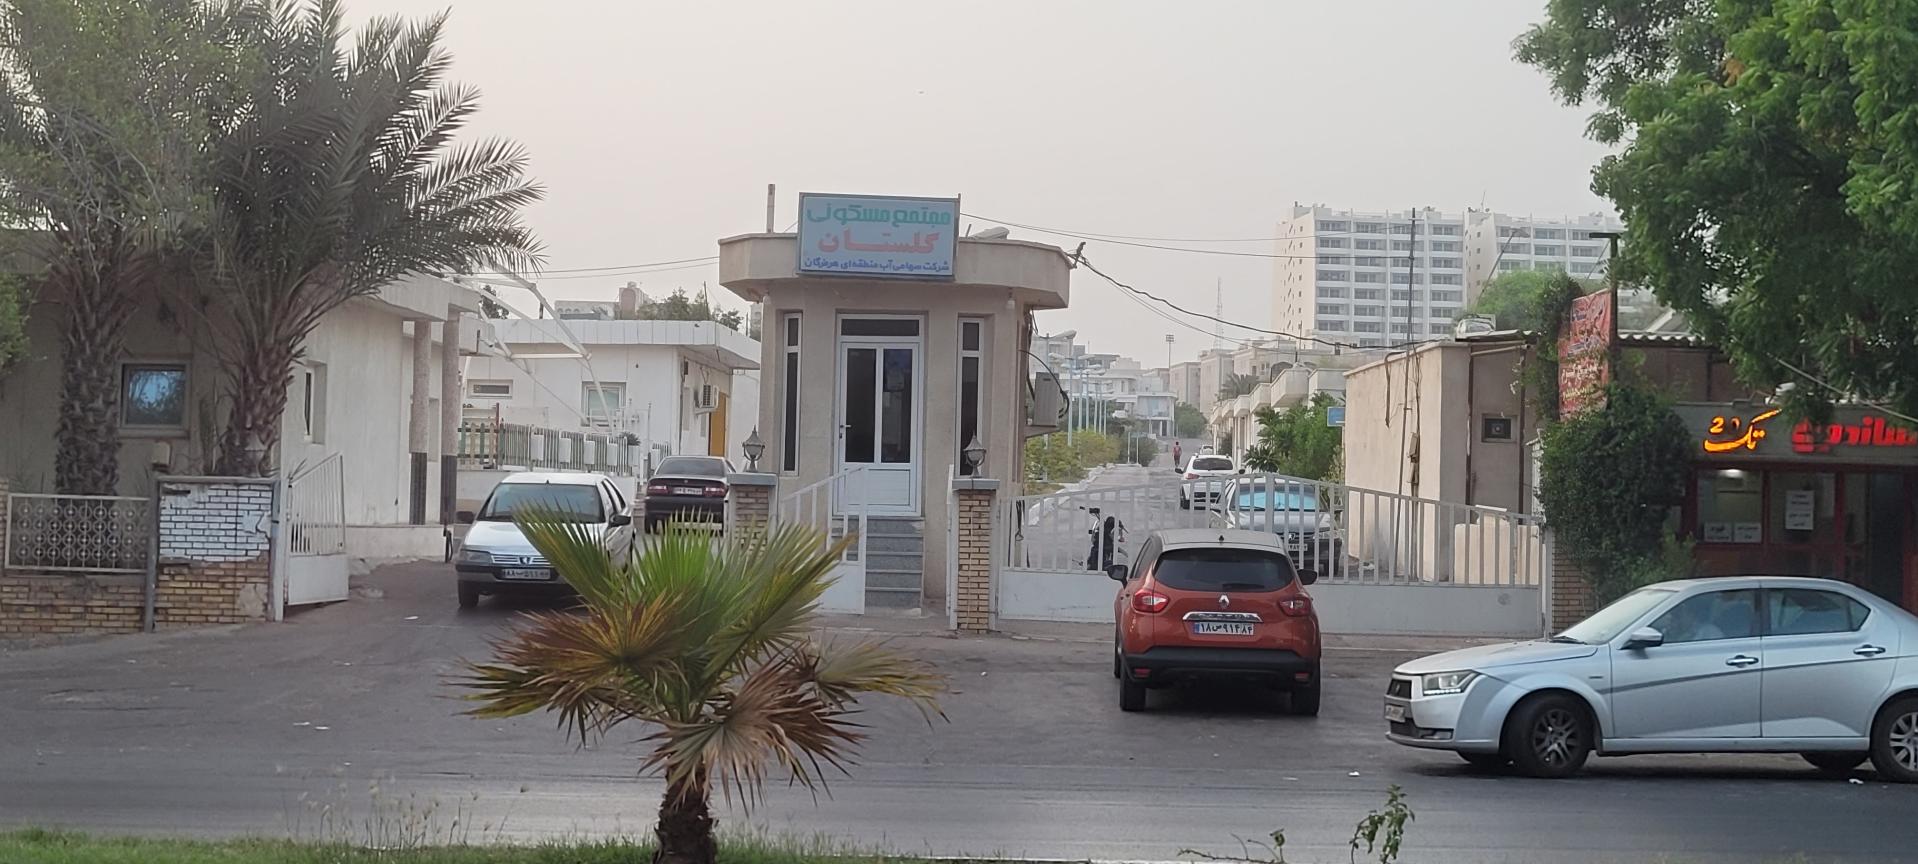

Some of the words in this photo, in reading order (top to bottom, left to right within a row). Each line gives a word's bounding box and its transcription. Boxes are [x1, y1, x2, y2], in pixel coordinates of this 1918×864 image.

[807, 202, 890, 226] مسکونی
[893, 206, 950, 228] مجتمع
[817, 228, 940, 254] گلستان
[804, 256, 839, 268] هرمزگان
[879, 259, 893, 272] آب
[892, 260, 922, 272] سهامی
[923, 260, 950, 272] شرکت
[1703, 408, 1782, 453] تک
[1792, 415, 1918, 454] ساندوچ
